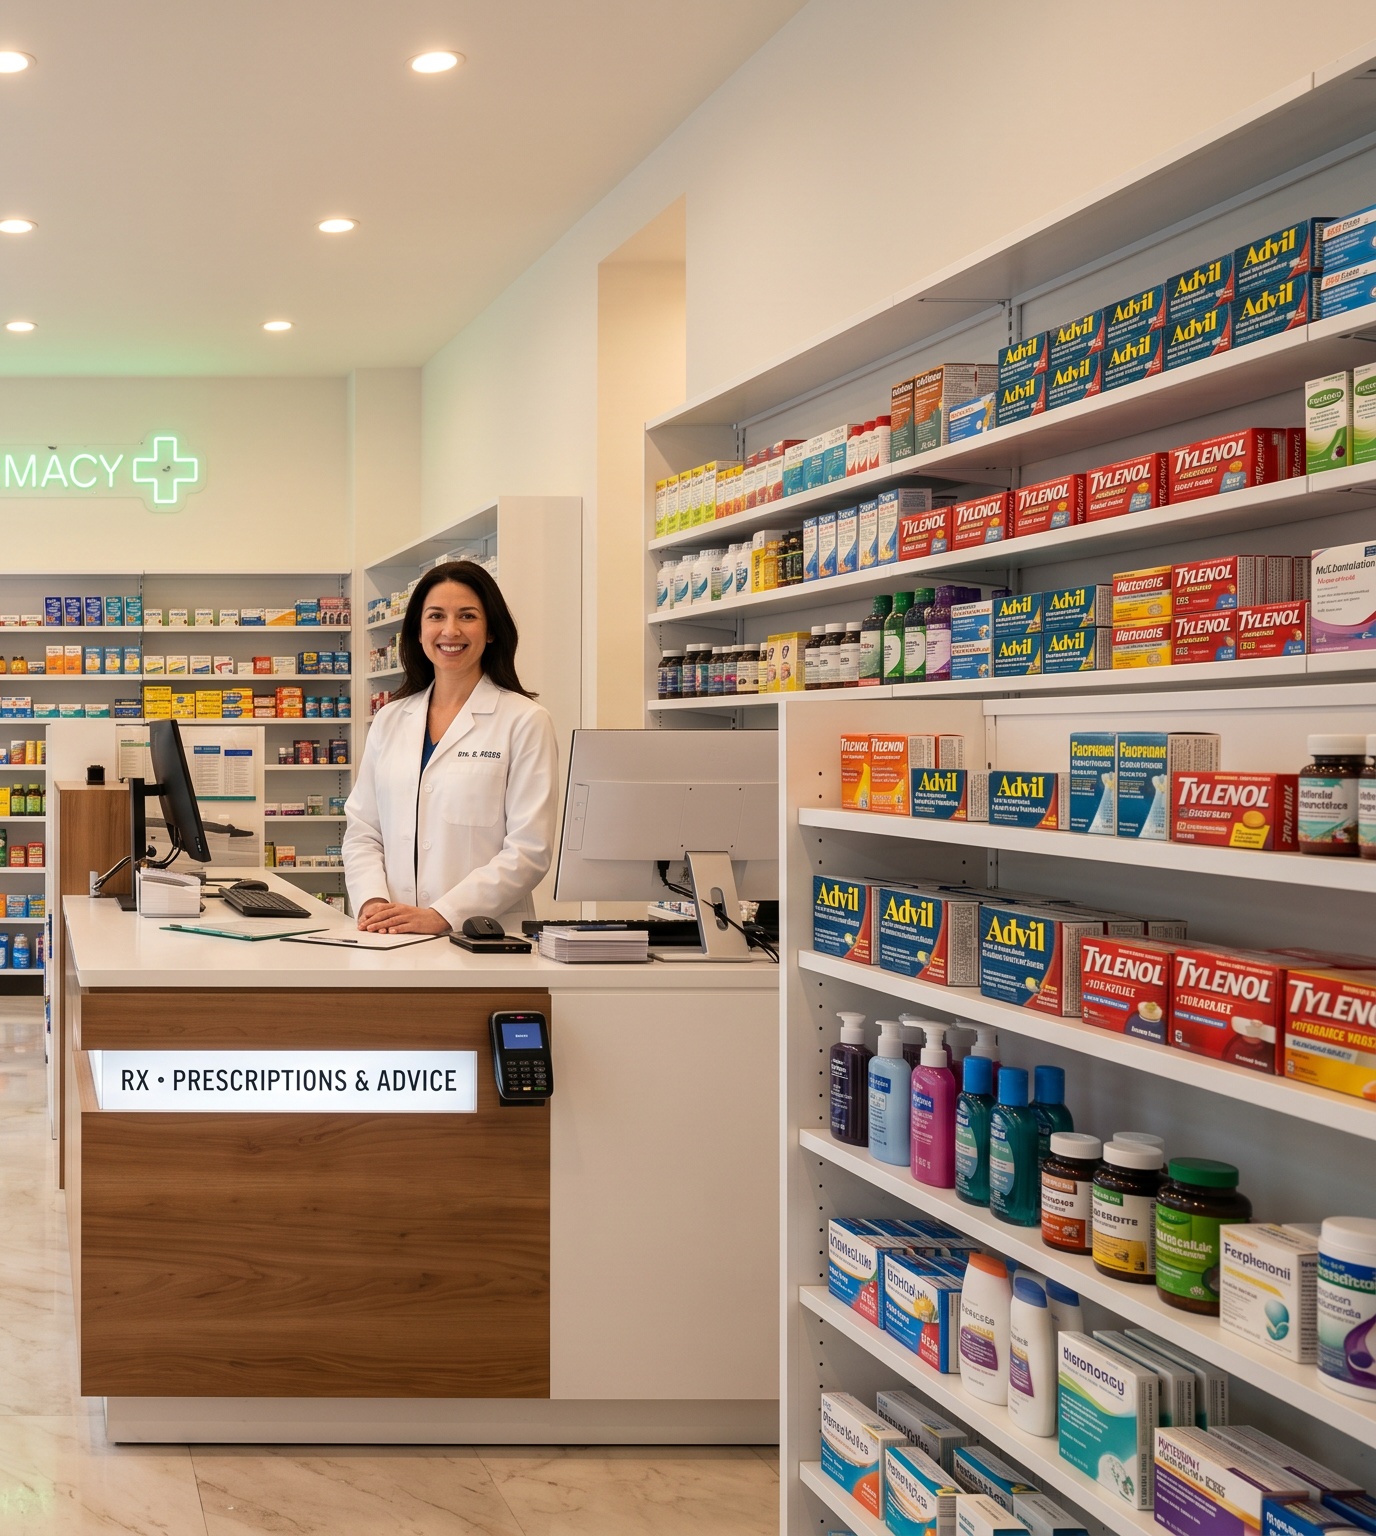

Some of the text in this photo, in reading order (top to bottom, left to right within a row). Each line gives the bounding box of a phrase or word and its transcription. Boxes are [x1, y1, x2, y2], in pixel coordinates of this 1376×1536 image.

[1243, 227, 1298, 268] Advil
[1174, 260, 1222, 298] Advil
[1111, 290, 1154, 324] Advil
[1240, 281, 1294, 320] Advil
[1055, 315, 1094, 346] Advil
[1170, 310, 1218, 346] Advil
[1003, 338, 1038, 366] Advil
[1108, 335, 1151, 368] Advil
[1052, 358, 1090, 388] Advil
[1002, 378, 1034, 406] Advil
[1174, 439, 1246, 474] TYLENOL
[1090, 462, 1151, 494] TYLENOL
[1018, 483, 1070, 511] TYLENOL
[1175, 565, 1233, 588] TYLENOL
[999, 598, 1032, 617] Advil
[1050, 589, 1085, 610] Advil
[1176, 616, 1231, 638] TYLENOL
[1238, 610, 1300, 632] TYLENOL
[999, 639, 1032, 657] Advil
[1049, 631, 1085, 652] Advil
[918, 772, 958, 792] Advil
[997, 775, 1045, 798] Advil
[1178, 777, 1270, 808] TYLENOL
[816, 882, 859, 912] Advil
[883, 896, 934, 928] Advil
[985, 916, 1045, 952] Advil
[1083, 945, 1164, 986] TYLENOL
[1176, 956, 1271, 1003] TYLENOL
[121, 1069, 149, 1092] RX
[174, 1068, 347, 1092] PRESCRIPTIONS
[356, 1069, 370, 1092] &
[377, 1069, 458, 1092] ADVICE
